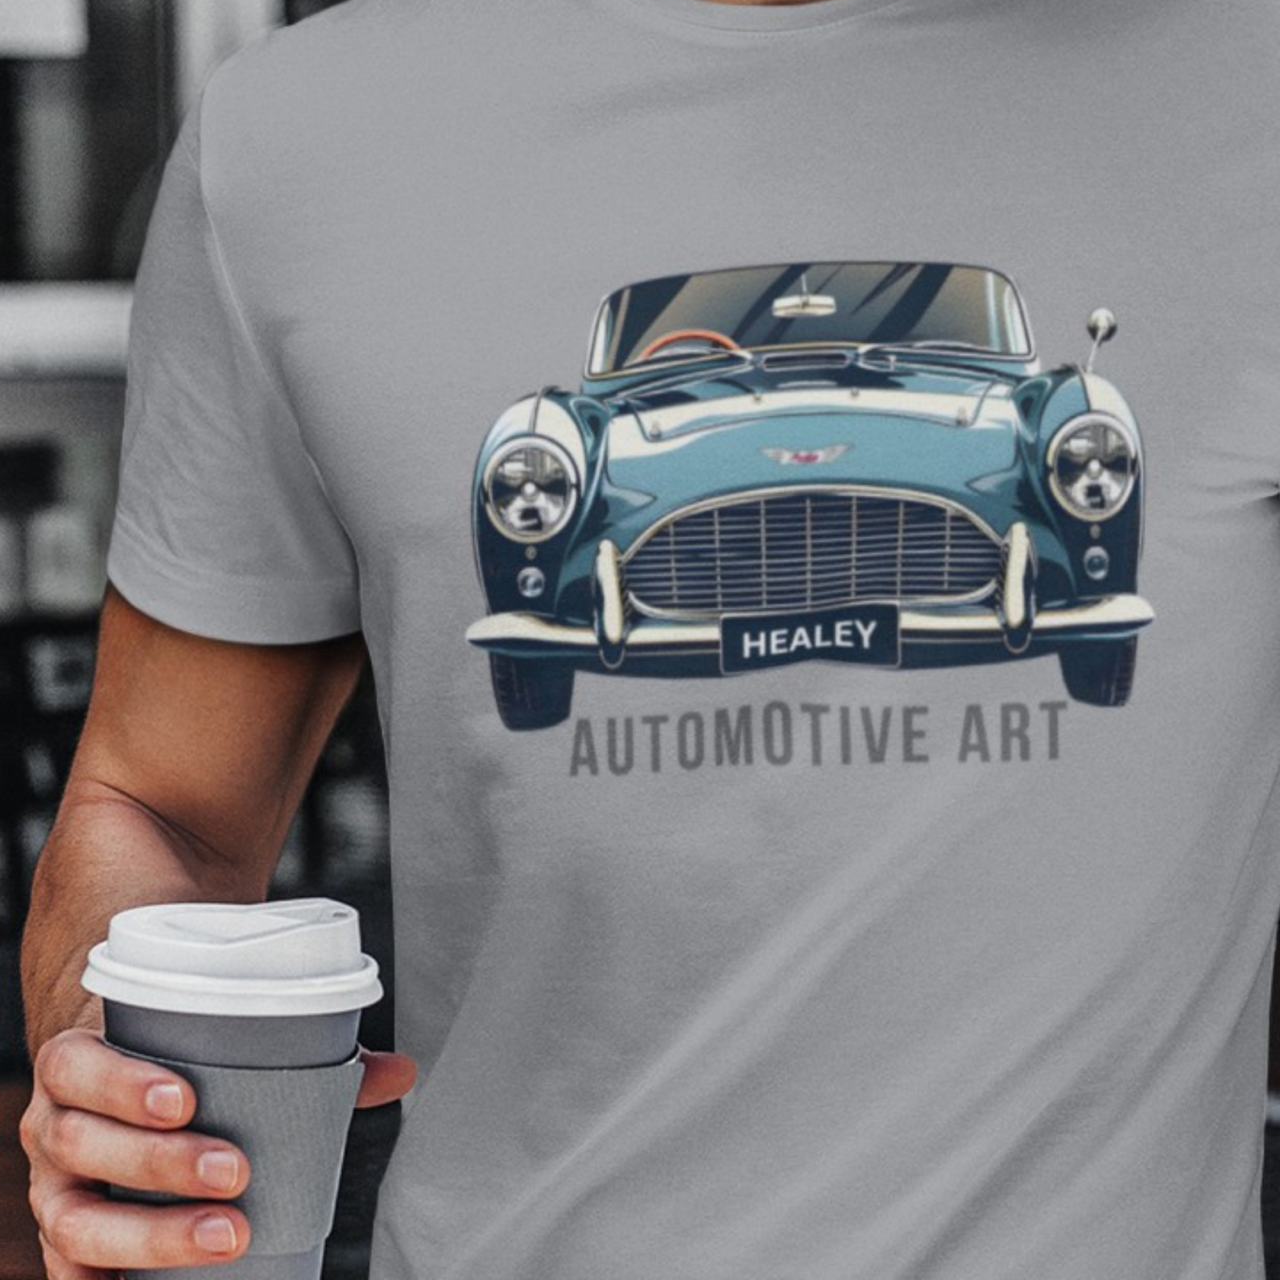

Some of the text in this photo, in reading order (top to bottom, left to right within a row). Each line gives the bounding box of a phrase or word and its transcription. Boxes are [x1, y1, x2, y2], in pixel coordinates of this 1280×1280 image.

[742, 619, 877, 658] HEALEY
[569, 700, 1068, 777] AUTOMOTIVE ART
